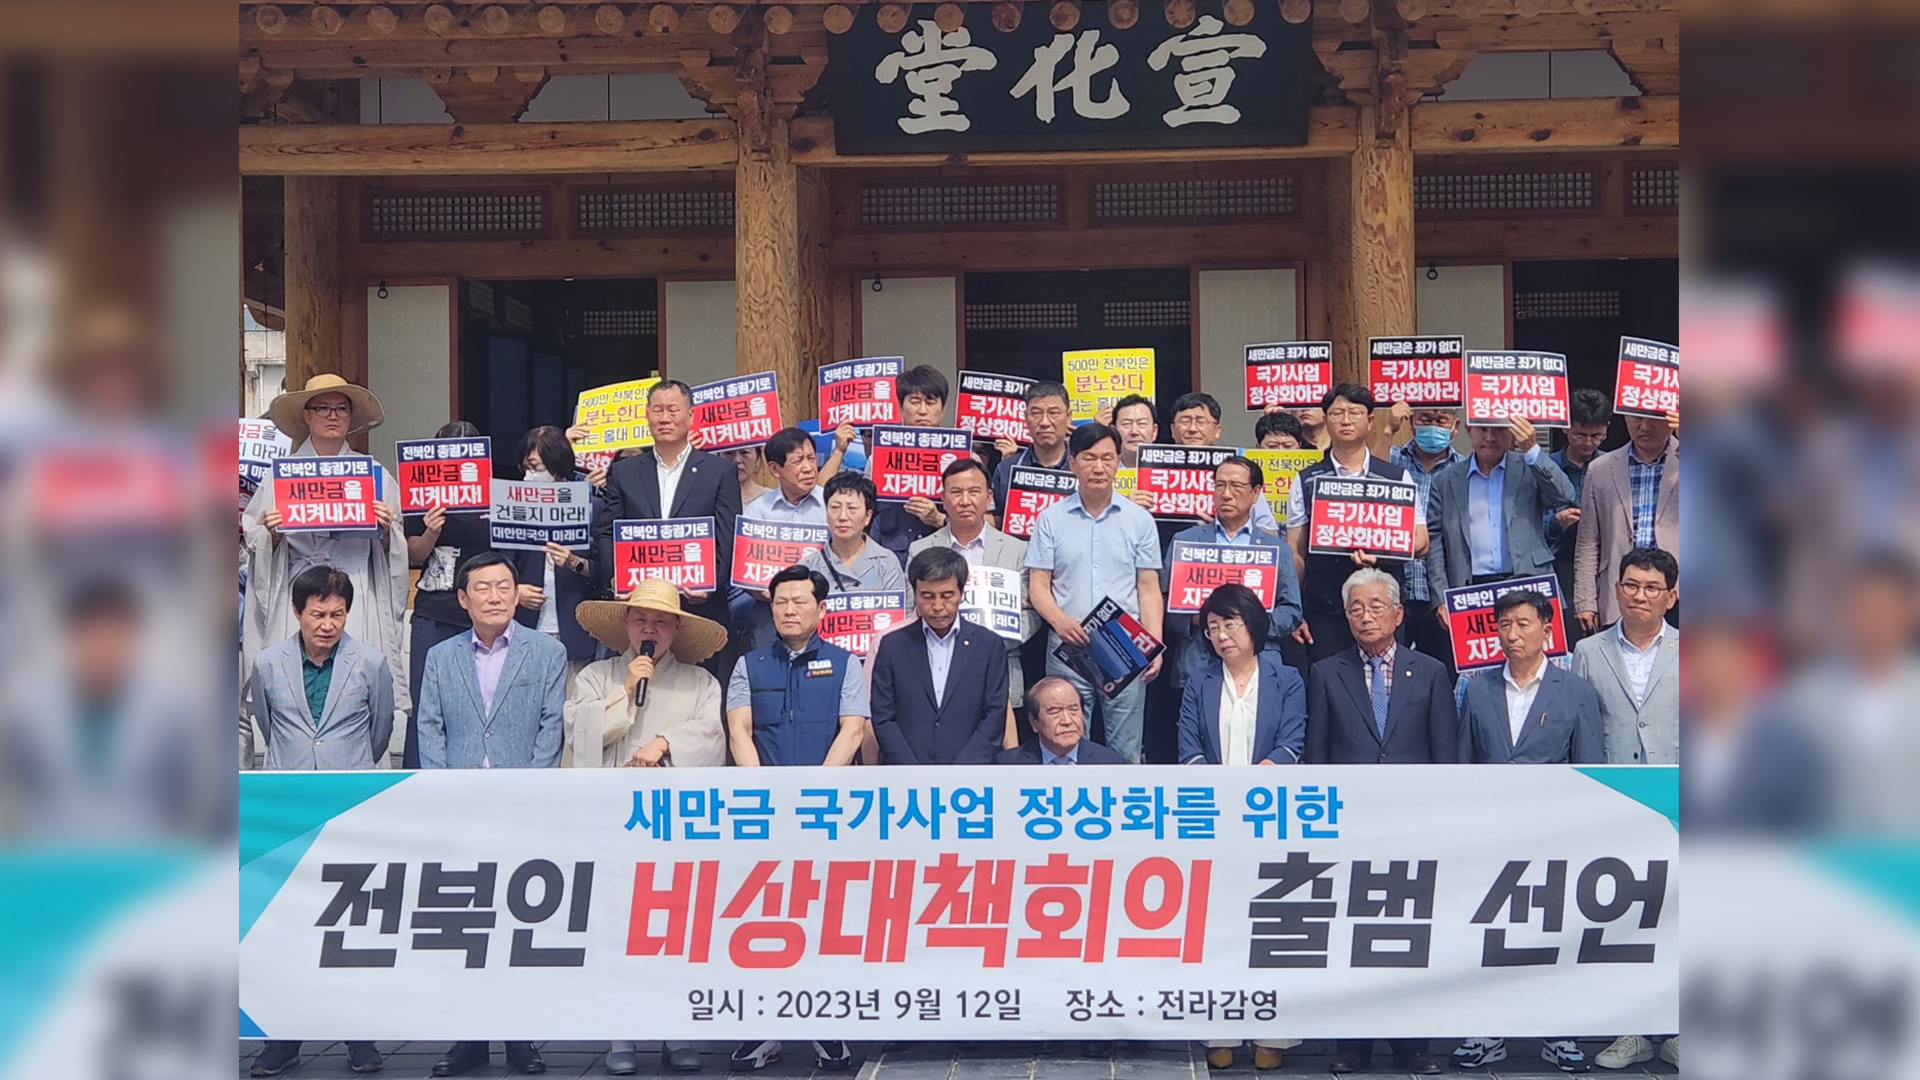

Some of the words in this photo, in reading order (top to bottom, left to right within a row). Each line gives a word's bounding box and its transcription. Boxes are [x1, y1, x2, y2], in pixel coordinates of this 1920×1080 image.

[1248, 348, 1285, 361] 새만금은
[1286, 347, 1307, 359] 죄가
[1308, 346, 1329, 358] 없다
[1372, 341, 1413, 355] 새만금은
[1415, 341, 1437, 354] 죄가
[1438, 340, 1461, 354] 없다
[1625, 342, 1669, 362] 새만금은
[824, 365, 851, 382] 전북인
[853, 362, 898, 377] 총궐기로
[1068, 358, 1099, 372] 500만
[1103, 356, 1149, 370] 전북인은
[1256, 363, 1320, 383] 국가사업
[1381, 359, 1450, 380] 국가사업
[1469, 355, 1516, 370] 새만금은
[1517, 356, 1541, 370] 죄가
[1542, 357, 1564, 372] 없다
[692, 384, 725, 403] 전북인
[726, 377, 772, 398] 총궐기로
[829, 380, 891, 404] 새만금을
[962, 376, 1003, 392] 새만금은
[1004, 381, 1024, 395] 죄가
[1076, 373, 1144, 394] 분노한다
[1373, 380, 1460, 402] 정상화하라
[1481, 375, 1555, 397] 국가사업
[582, 392, 609, 409] 500만
[700, 397, 767, 424] 새만금을
[1472, 397, 1566, 420] 정상화하라
[603, 427, 629, 443] 홀대
[879, 431, 915, 446] 전북인
[918, 432, 967, 449] 총궐기로
[402, 445, 435, 460] 전북인
[437, 442, 486, 459] 총궐기로
[1141, 449, 1186, 464] 새만금은
[1187, 451, 1211, 465] 죄가
[279, 462, 316, 477] 전북인
[319, 461, 369, 476] 총궐기로
[410, 461, 479, 483] 새만금을
[289, 480, 362, 501] 새만금을
[1013, 471, 1056, 490] 새만금은
[1114, 477, 1137, 490] 500
[409, 485, 482, 507] 지켜내자!
[507, 486, 572, 503] 새만금을
[1318, 481, 1364, 497] 새만금은
[1366, 483, 1391, 499] 죄가
[1391, 486, 1414, 501] 없다
[288, 502, 366, 523] 지켜내자!
[496, 504, 543, 522] 건들지
[550, 505, 586, 524] 마라!
[1327, 502, 1402, 527] 국가사업
[492, 525, 549, 542] 대한민국의
[552, 527, 587, 542] 미래다
[620, 525, 657, 540] 전북인
[660, 522, 709, 538] 총궐기로
[741, 522, 777, 539] 전북인
[780, 527, 828, 542] 총궐기로
[1316, 524, 1411, 552] 정상화하라
[629, 541, 702, 564] 새만금을
[1181, 547, 1219, 562] 전북인
[1221, 549, 1273, 564] 총궐기로
[1186, 567, 1263, 587] 새만금을
[850, 595, 900, 609] 총궐기로
[1452, 590, 1494, 610] 전북인
[819, 612, 892, 635] 새만금을
[624, 787, 776, 842] 새만금
[795, 787, 994, 842] 국가사업
[1016, 786, 1221, 840] 정상화를
[1241, 786, 1344, 840] 위한
[313, 858, 596, 968] 전북인
[624, 852, 1212, 969] 비상대책회의
[1247, 851, 1438, 968] 출범
[1469, 855, 1669, 967] 선언
[688, 989, 745, 1021] 일시
[775, 989, 880, 1021] 2023년
[893, 989, 943, 1021] 9월
[956, 989, 1022, 1021] 12일
[1065, 990, 1126, 1022] 장소
[1157, 990, 1279, 1021] 전라감영
